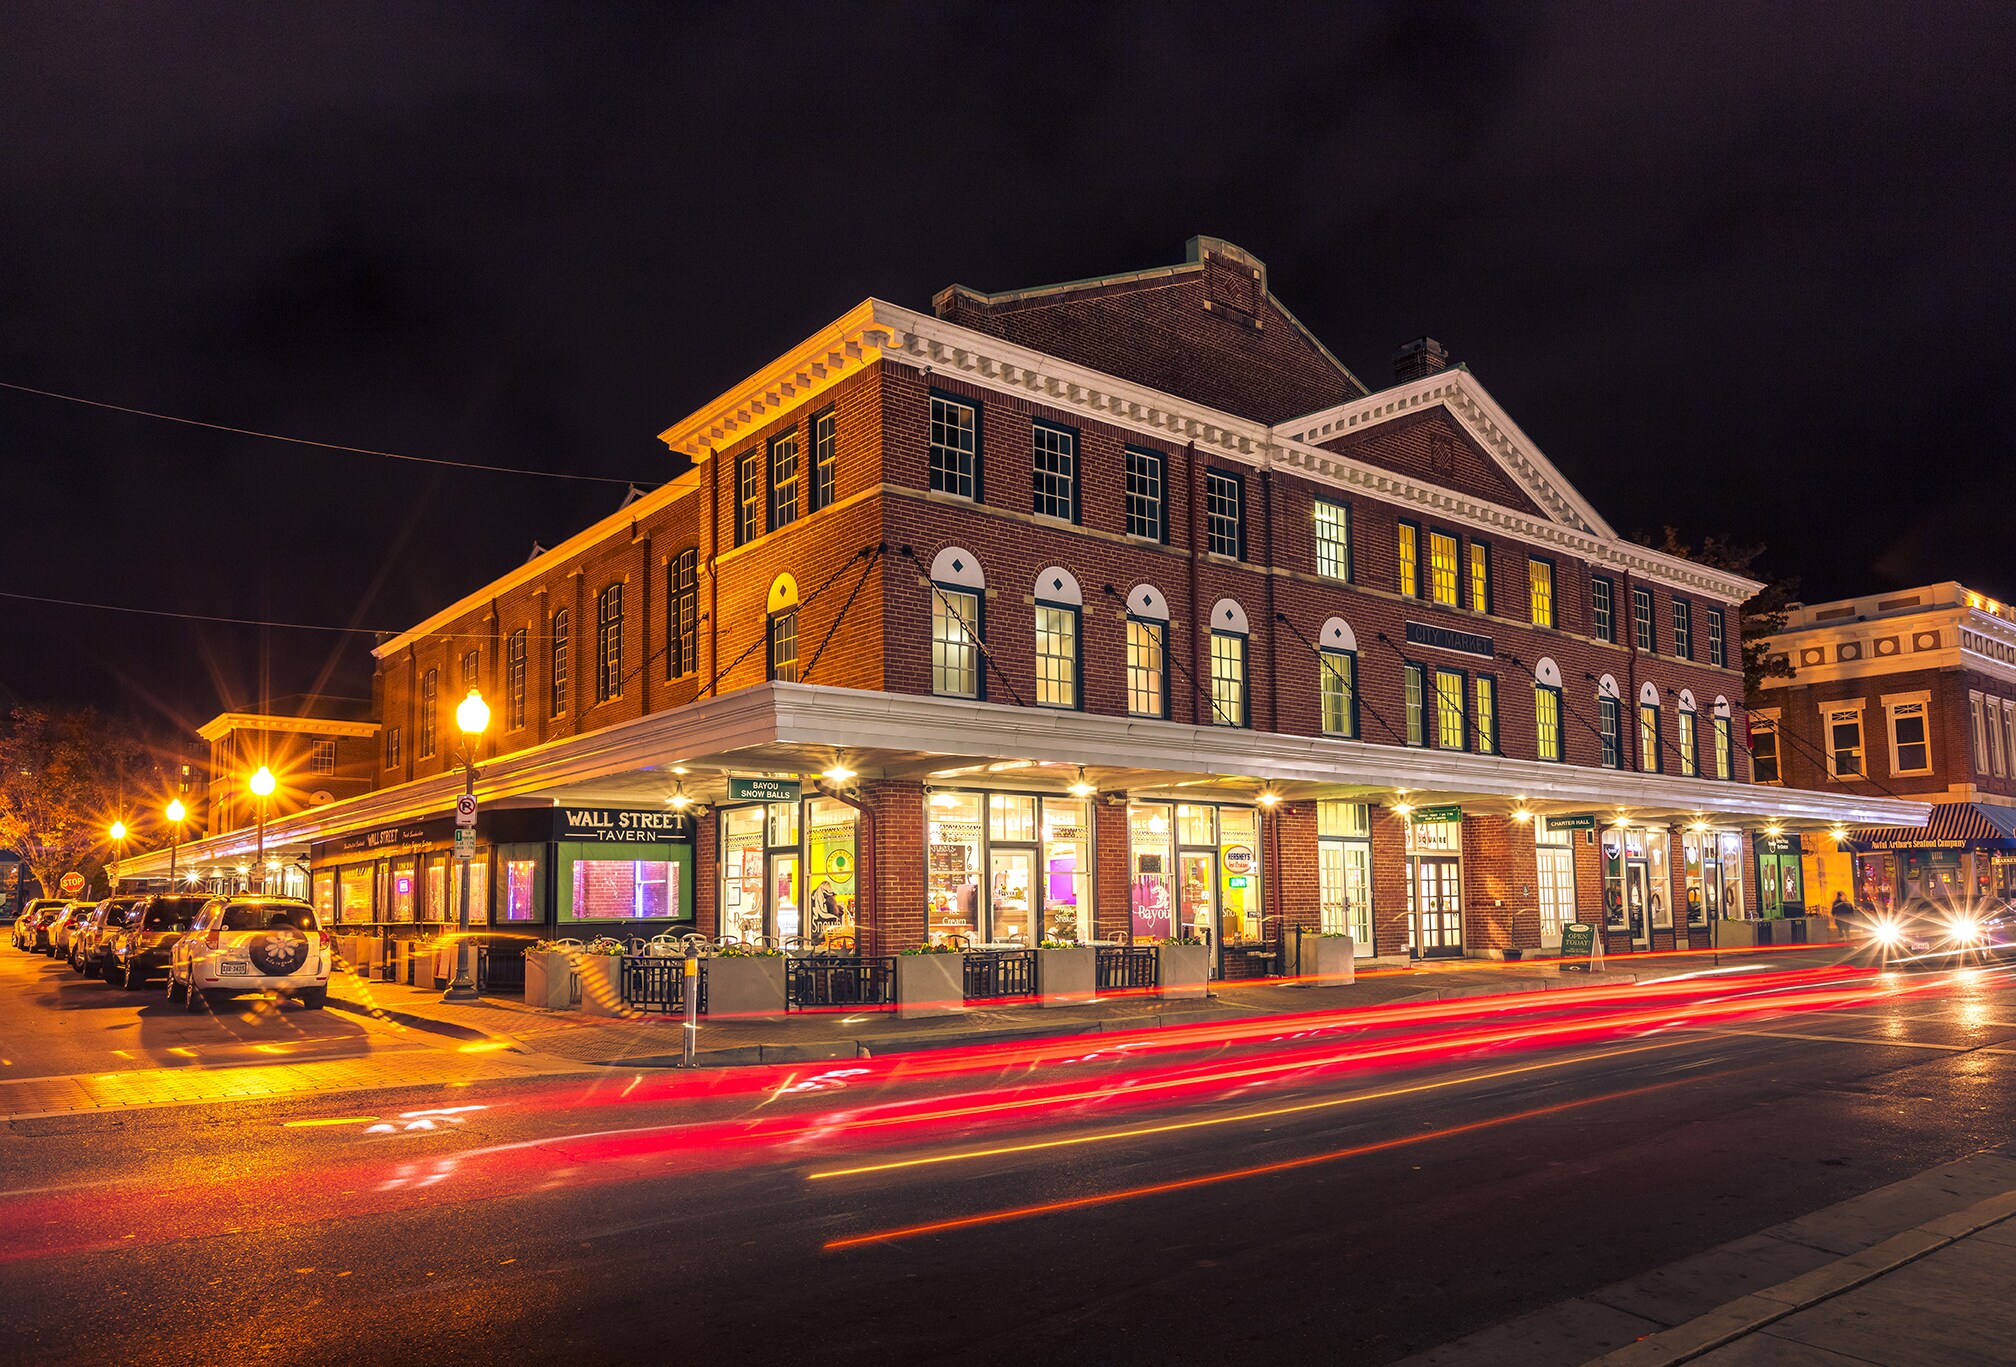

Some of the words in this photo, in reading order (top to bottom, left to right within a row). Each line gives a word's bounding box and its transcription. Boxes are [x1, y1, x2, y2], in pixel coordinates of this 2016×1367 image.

[1415, 626, 1439, 643] CITY
[1444, 632, 1488, 653] MARKET
[752, 781, 779, 790] BAYOU
[741, 789, 765, 798] SNOW
[766, 790, 790, 799] BALLS
[565, 810, 614, 828] WALL
[618, 811, 686, 829] STREET
[367, 832, 380, 847] WALL
[380, 828, 399, 845] STREET
[596, 829, 656, 841] TAVERN
[1418, 836, 1447, 845] SQUARE
[1871, 841, 1887, 849] Awful
[1888, 840, 1912, 849] Arthur's
[1912, 839, 1937, 849] Seafood
[1937, 838, 1966, 849] Company
[1228, 853, 1251, 861] HERSHEY'S
[62, 877, 82, 887] STOP
[942, 916, 967, 925] Cream
[1138, 905, 1170, 928] Bayou
